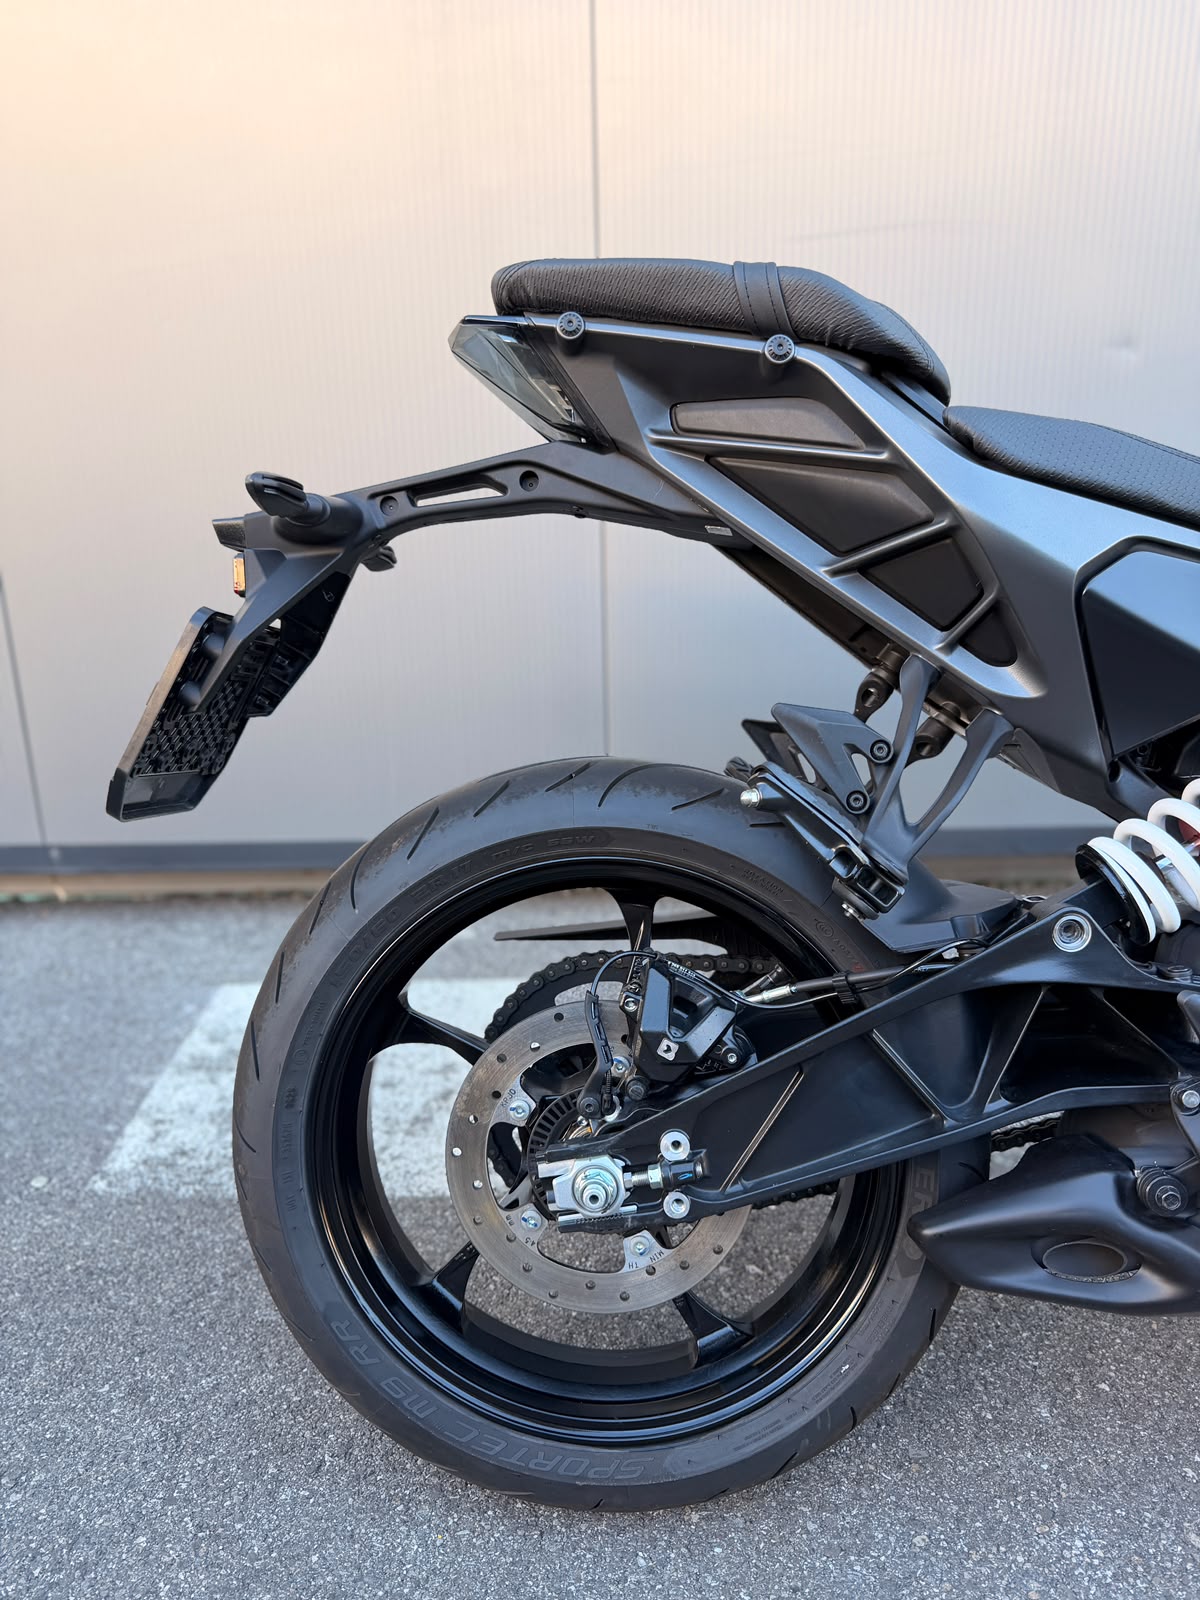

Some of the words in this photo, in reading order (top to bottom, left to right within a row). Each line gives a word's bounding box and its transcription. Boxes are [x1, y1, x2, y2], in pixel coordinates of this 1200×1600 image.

[627, 1260, 639, 1269] TH
[648, 1249, 665, 1263] MIN
[379, 1376, 438, 1419] M9
[445, 1421, 654, 1479] SPORTEC
